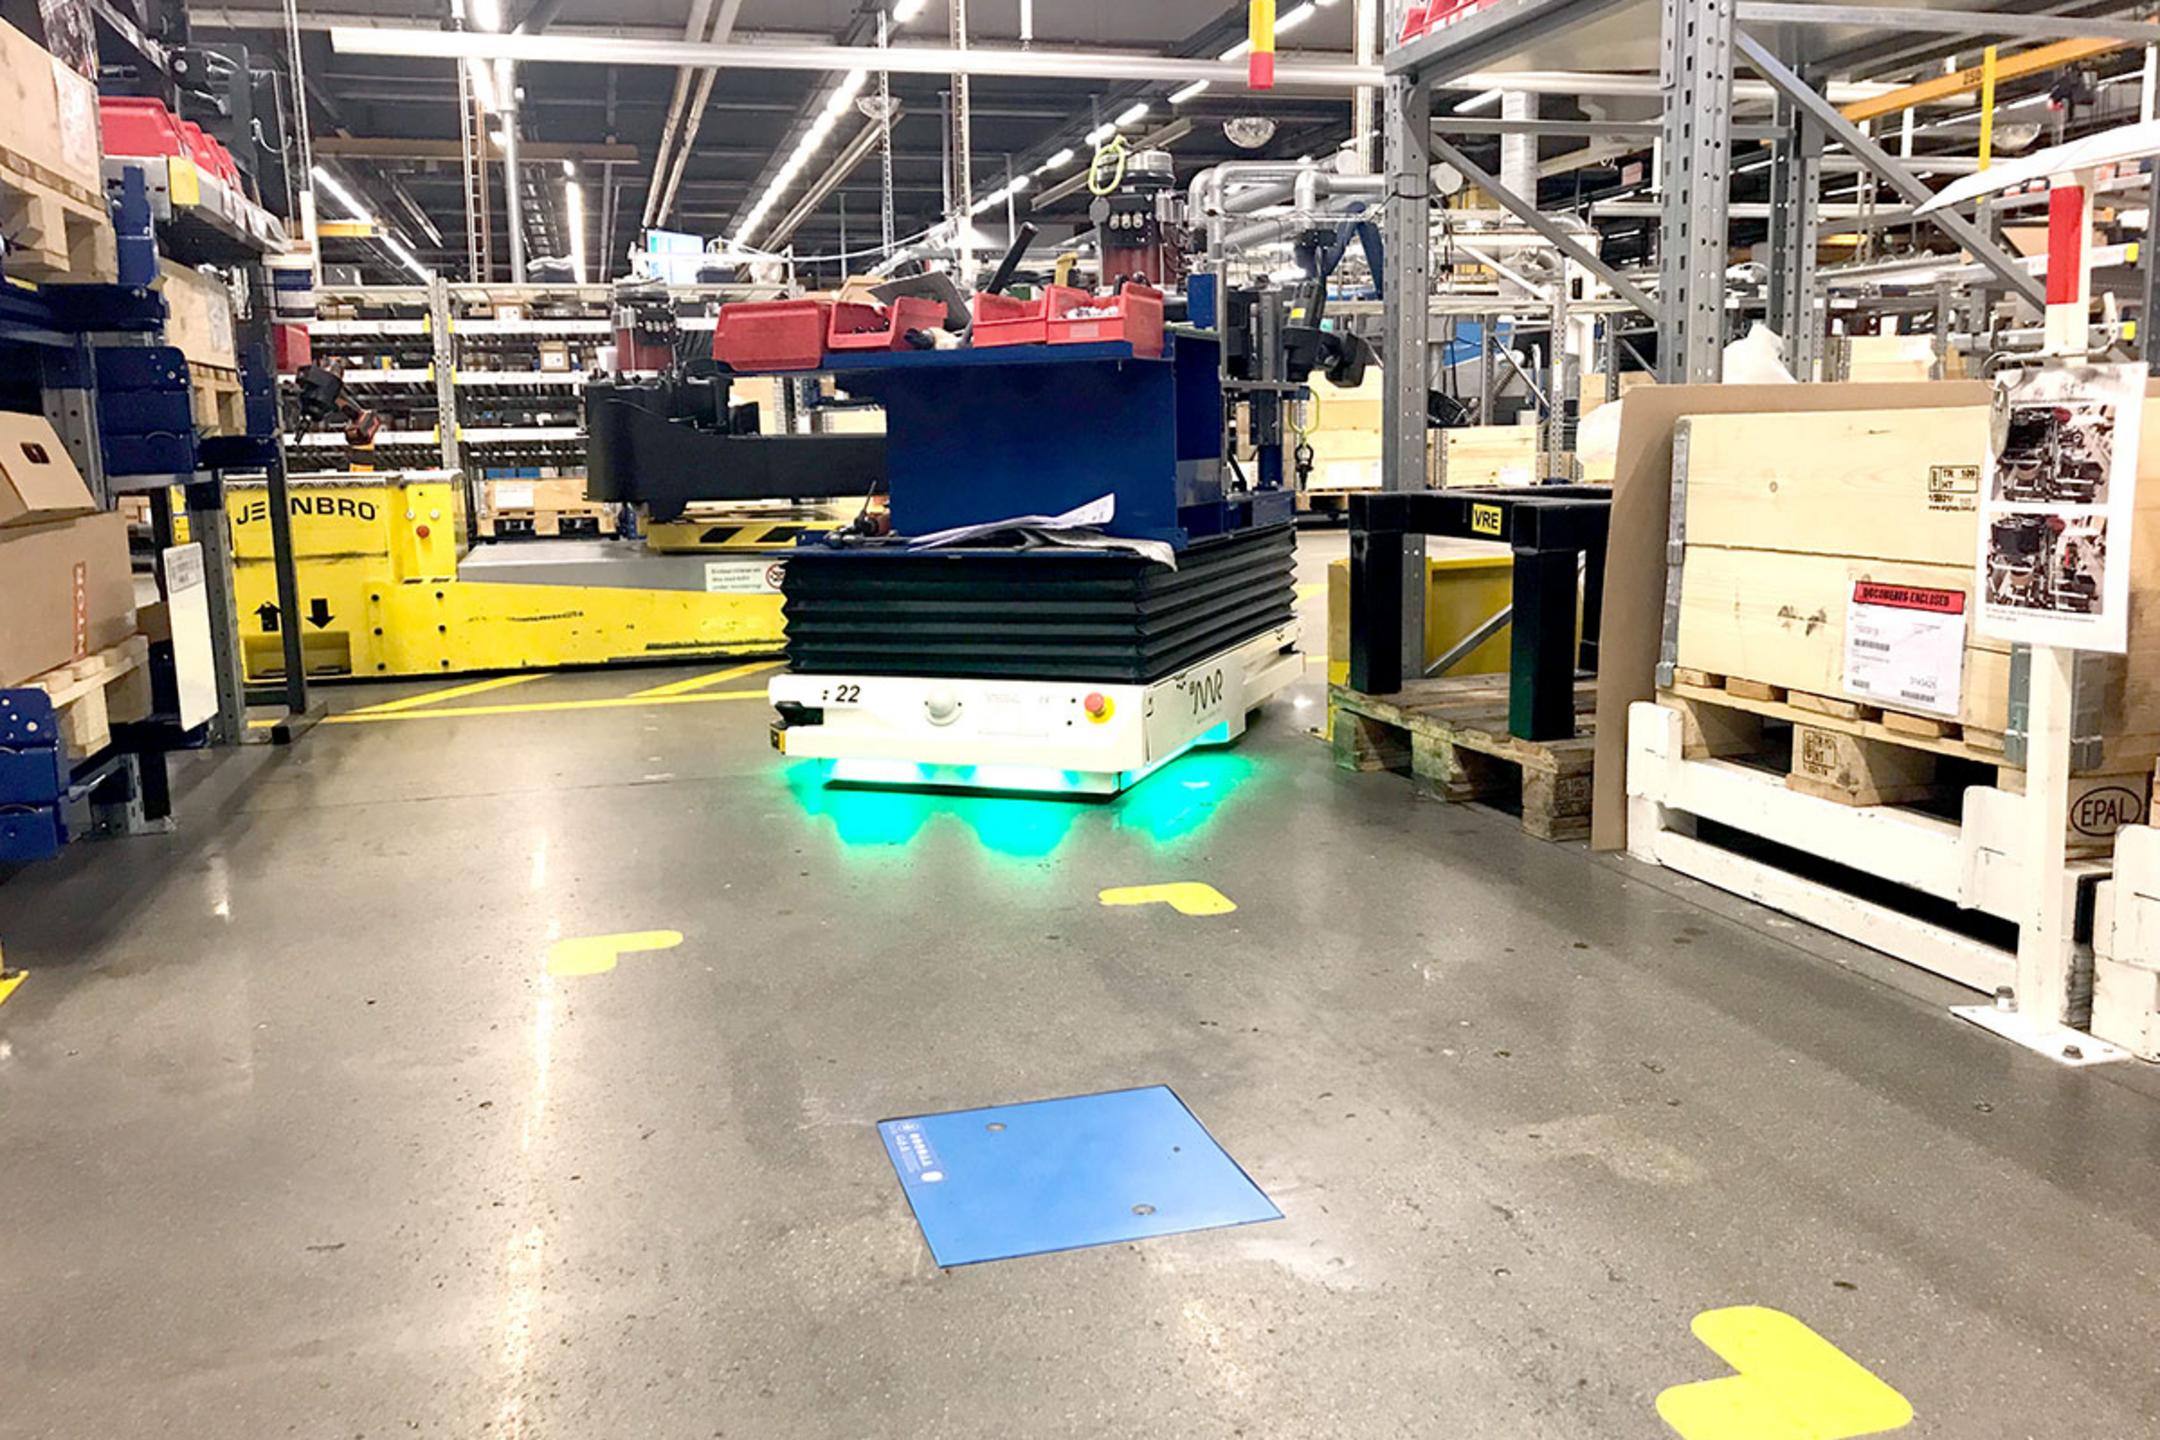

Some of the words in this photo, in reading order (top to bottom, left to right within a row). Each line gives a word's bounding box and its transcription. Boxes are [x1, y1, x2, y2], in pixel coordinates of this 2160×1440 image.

[236, 496, 376, 525] JENBRO
[1474, 508, 1499, 530] VRE
[1910, 592, 1950, 607] ENCLOSED
[835, 685, 861, 703] 22
[2080, 797, 2130, 827] EPAL
